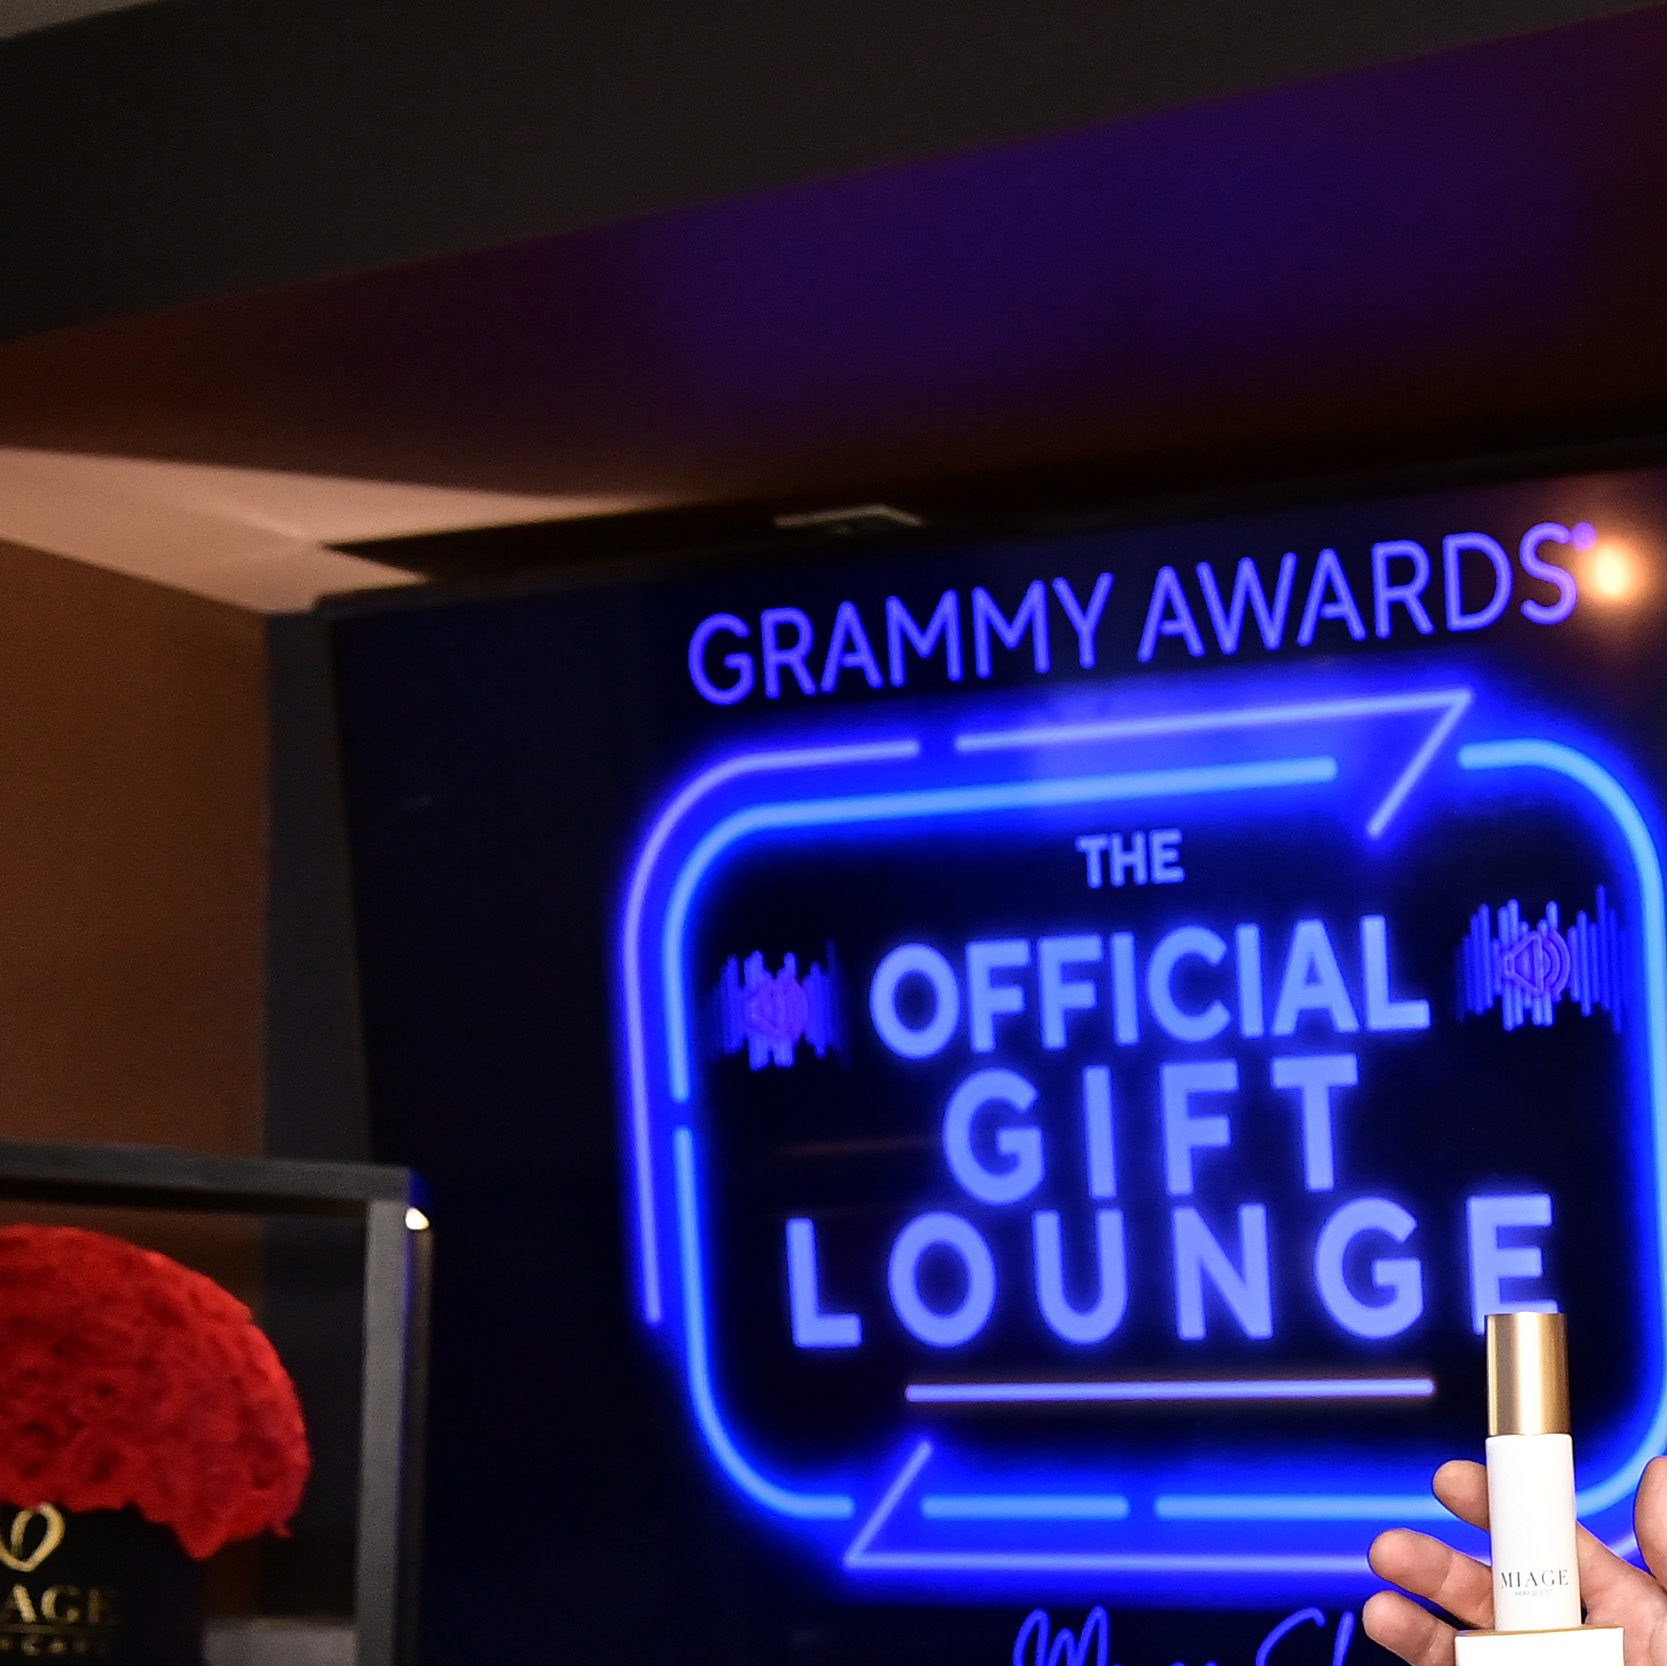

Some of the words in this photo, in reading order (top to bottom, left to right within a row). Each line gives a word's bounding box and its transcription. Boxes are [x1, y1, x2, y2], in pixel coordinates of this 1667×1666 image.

[688, 571, 1113, 706] GRAMMY
[1137, 521, 1580, 664] AWARDS
[1076, 830, 1184, 888] THE
[868, 914, 1430, 1058] OFFICIAL
[943, 1054, 1359, 1204] GIFT
[786, 1191, 1556, 1350] LOUNGE
[1500, 1569, 1570, 1589] MIAGE
